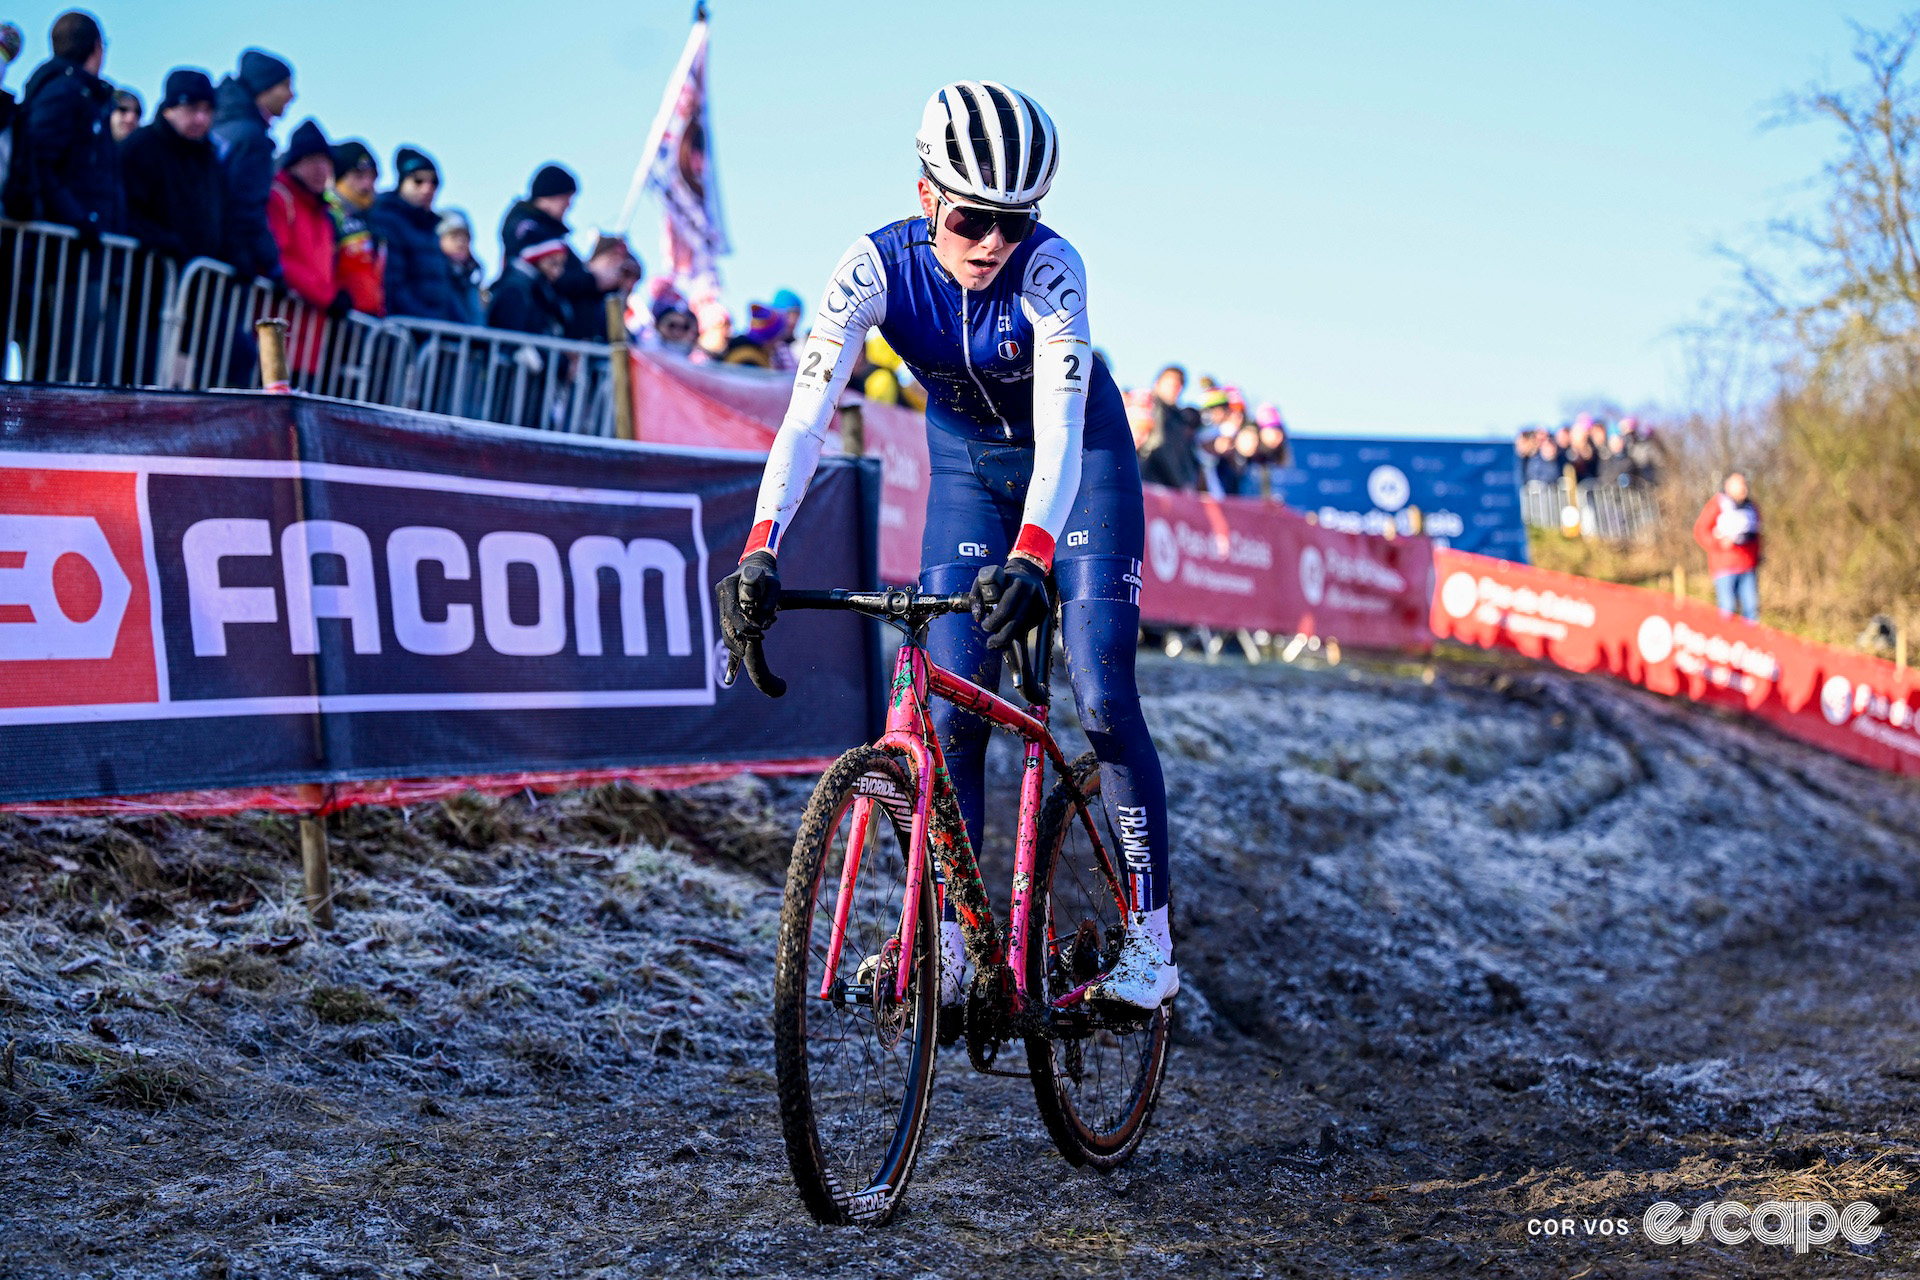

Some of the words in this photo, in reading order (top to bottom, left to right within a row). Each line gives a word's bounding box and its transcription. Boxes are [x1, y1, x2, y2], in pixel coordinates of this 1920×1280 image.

[827, 263, 873, 314] CIC
[1032, 263, 1081, 311] CIC
[802, 351, 822, 377] 2
[1063, 354, 1081, 381] 2
[182, 517, 693, 657] FACOM
[859, 776, 897, 798] EVORIDE
[1118, 805, 1152, 873] FRANCE
